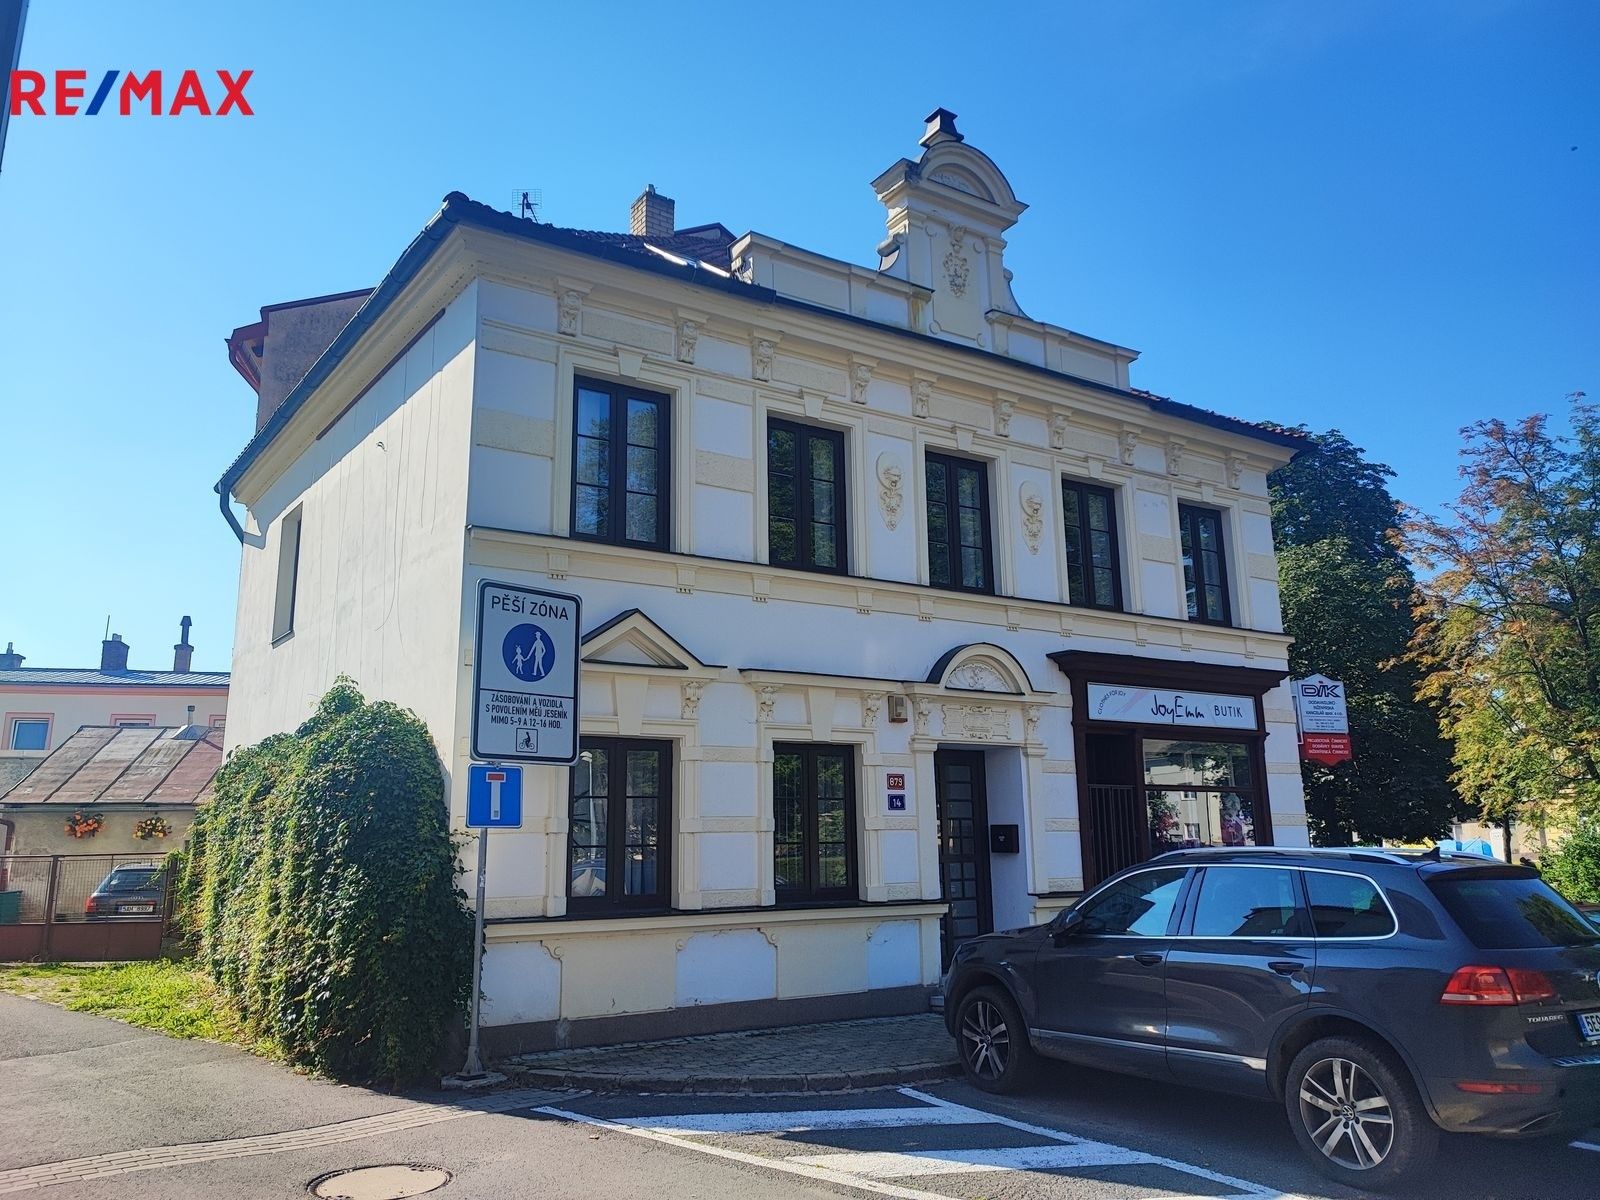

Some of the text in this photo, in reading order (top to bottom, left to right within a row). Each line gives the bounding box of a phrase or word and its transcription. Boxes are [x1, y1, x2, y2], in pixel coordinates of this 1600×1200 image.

[491, 593, 569, 621] PĚŠÍ ZÓNA
[491, 692, 564, 709] ZÁSOBOVÁNÍ A VOZIDLA
[485, 703, 490, 713] S
[491, 704, 528, 716] POVOLENÍM
[543, 707, 568, 719] JESENÍK
[1214, 705, 1243, 719] BUTIK
[491, 715, 509, 725] MIMO
[523, 719, 528, 727] A
[548, 720, 562, 729] HOD.
[889, 777, 903, 786] 879
[892, 798, 902, 808] 14
[1527, 1014, 1564, 1023] TOUAREG
